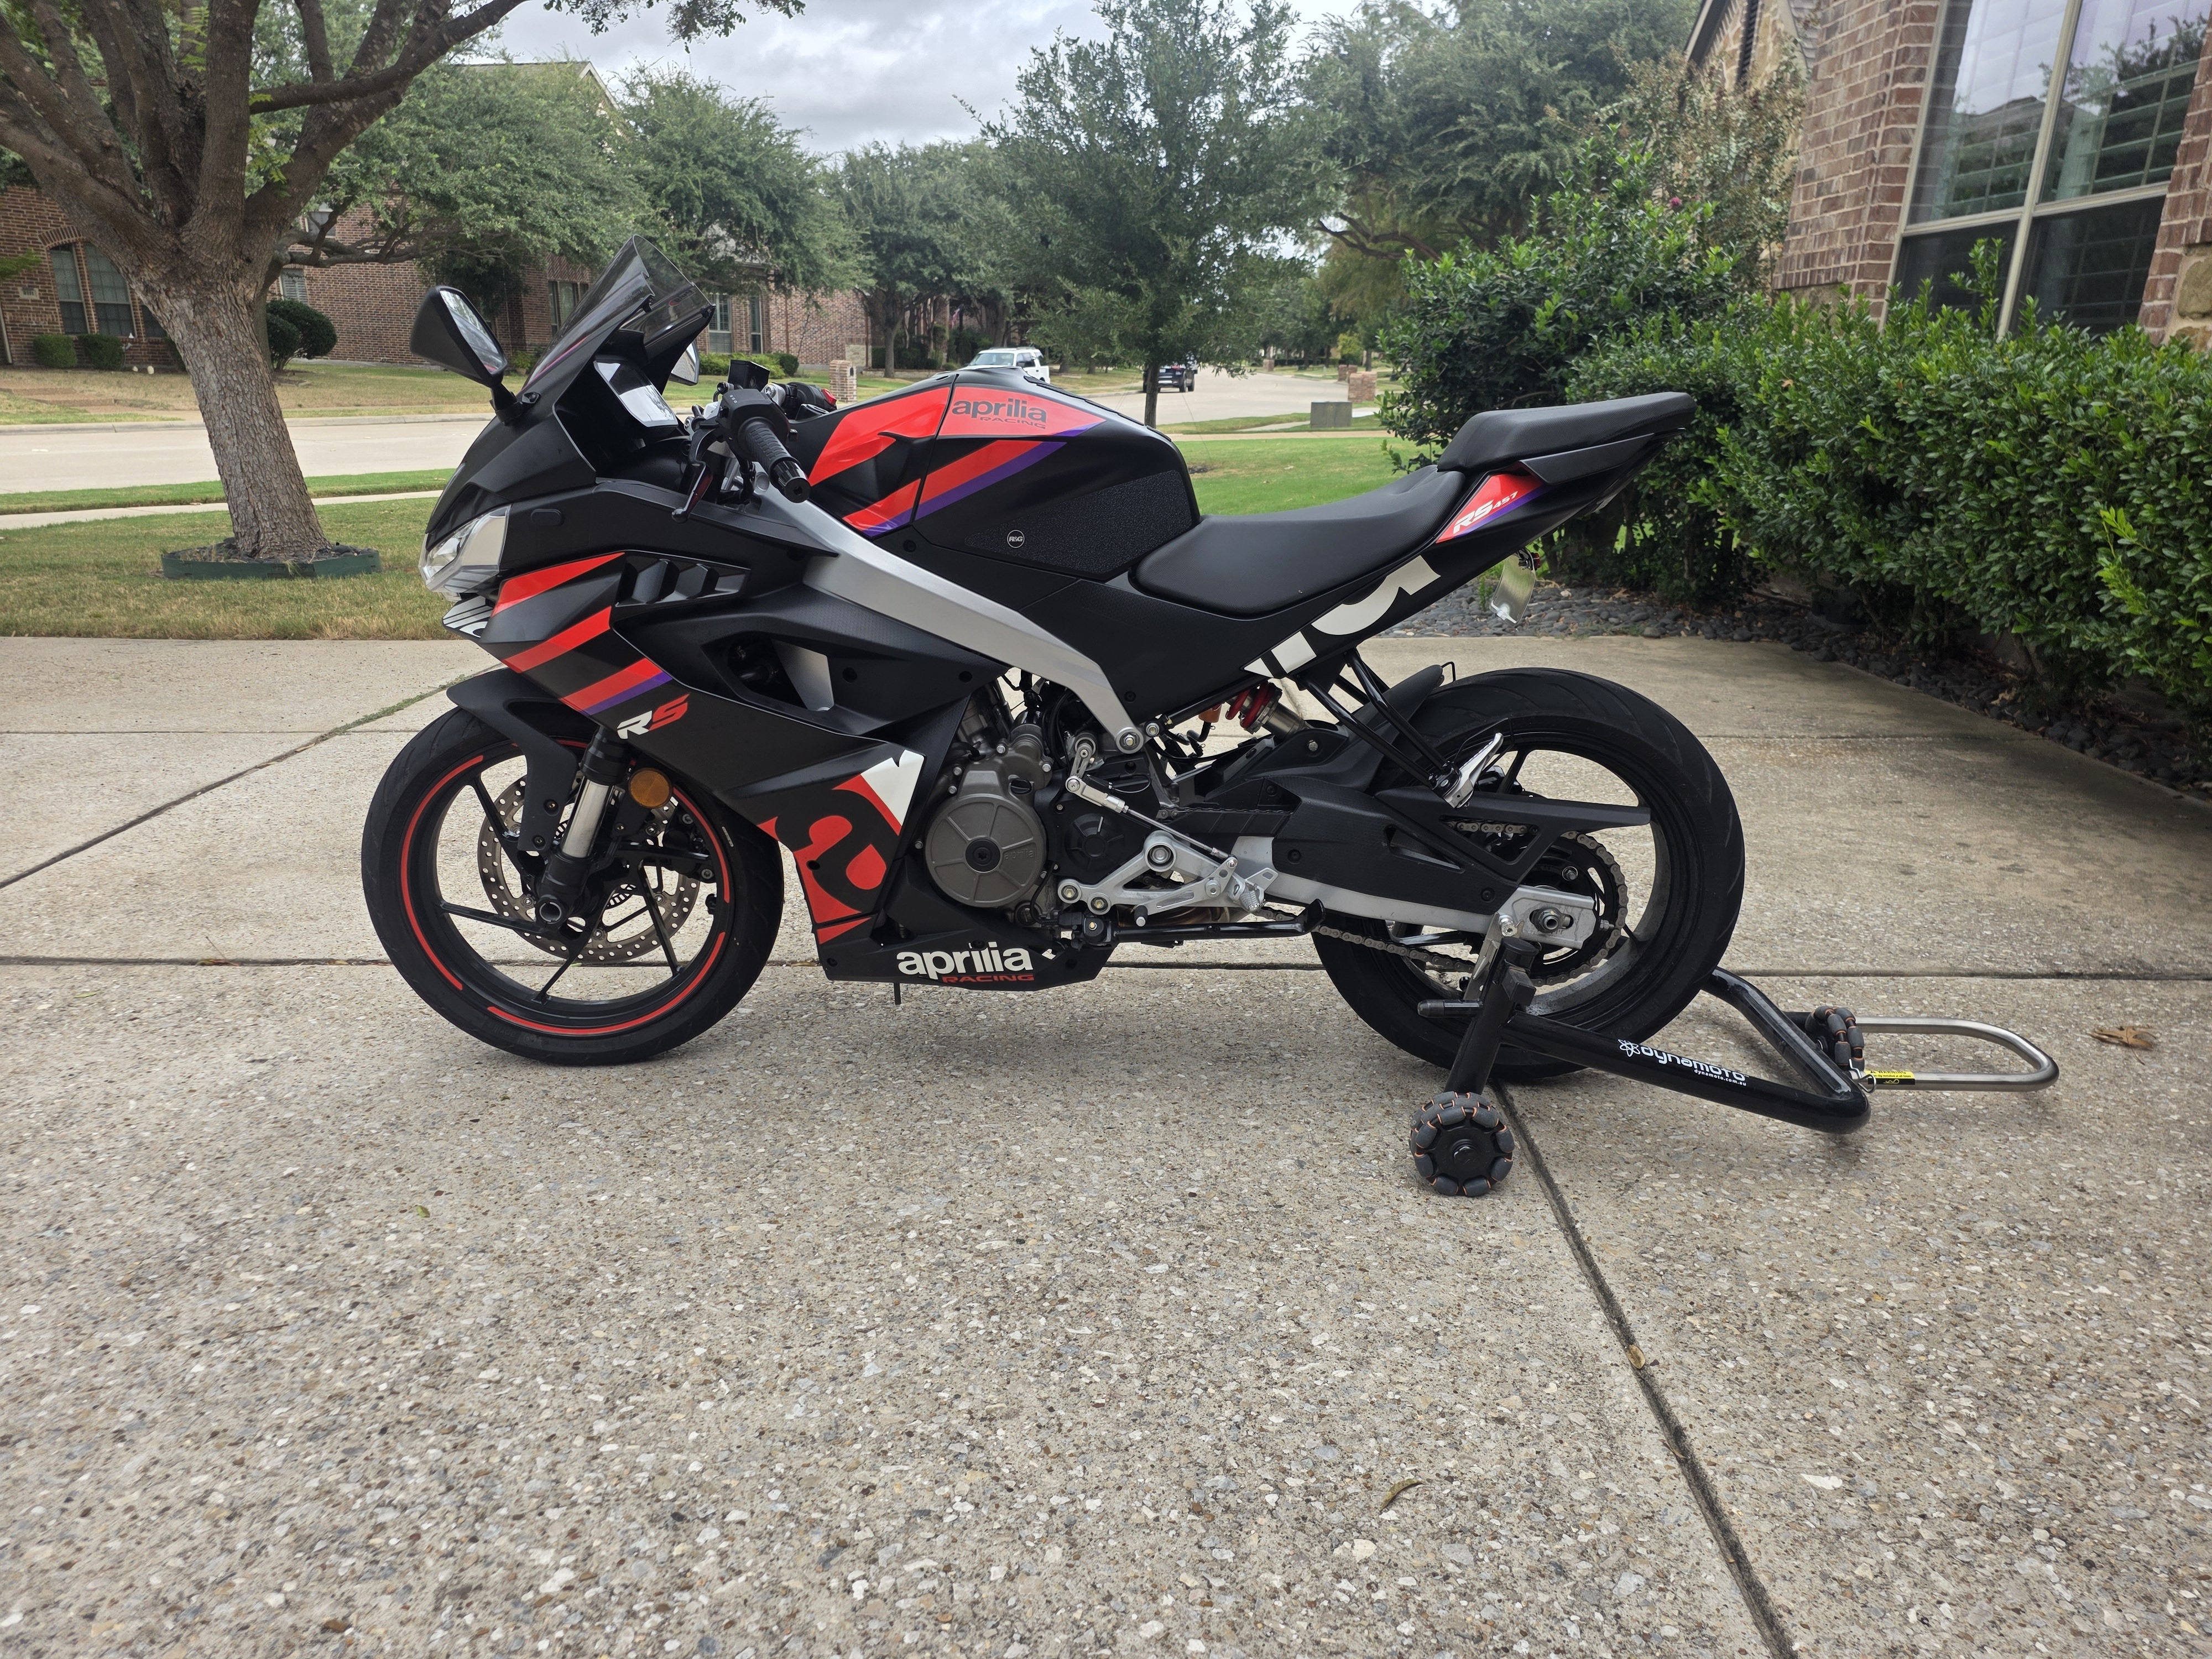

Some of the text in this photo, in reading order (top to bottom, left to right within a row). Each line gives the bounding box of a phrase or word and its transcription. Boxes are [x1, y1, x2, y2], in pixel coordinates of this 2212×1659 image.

[952, 398, 1047, 424] aprilia
[979, 416, 1046, 430] RACING
[1453, 491, 1518, 534] RS 457
[617, 692, 690, 739] RS
[896, 941, 1034, 980] aprilia
[941, 973, 1035, 983] RACING
[1640, 1046, 1746, 1082] dynamoto
[1694, 1069, 1747, 1086] dynamoto.com.au
